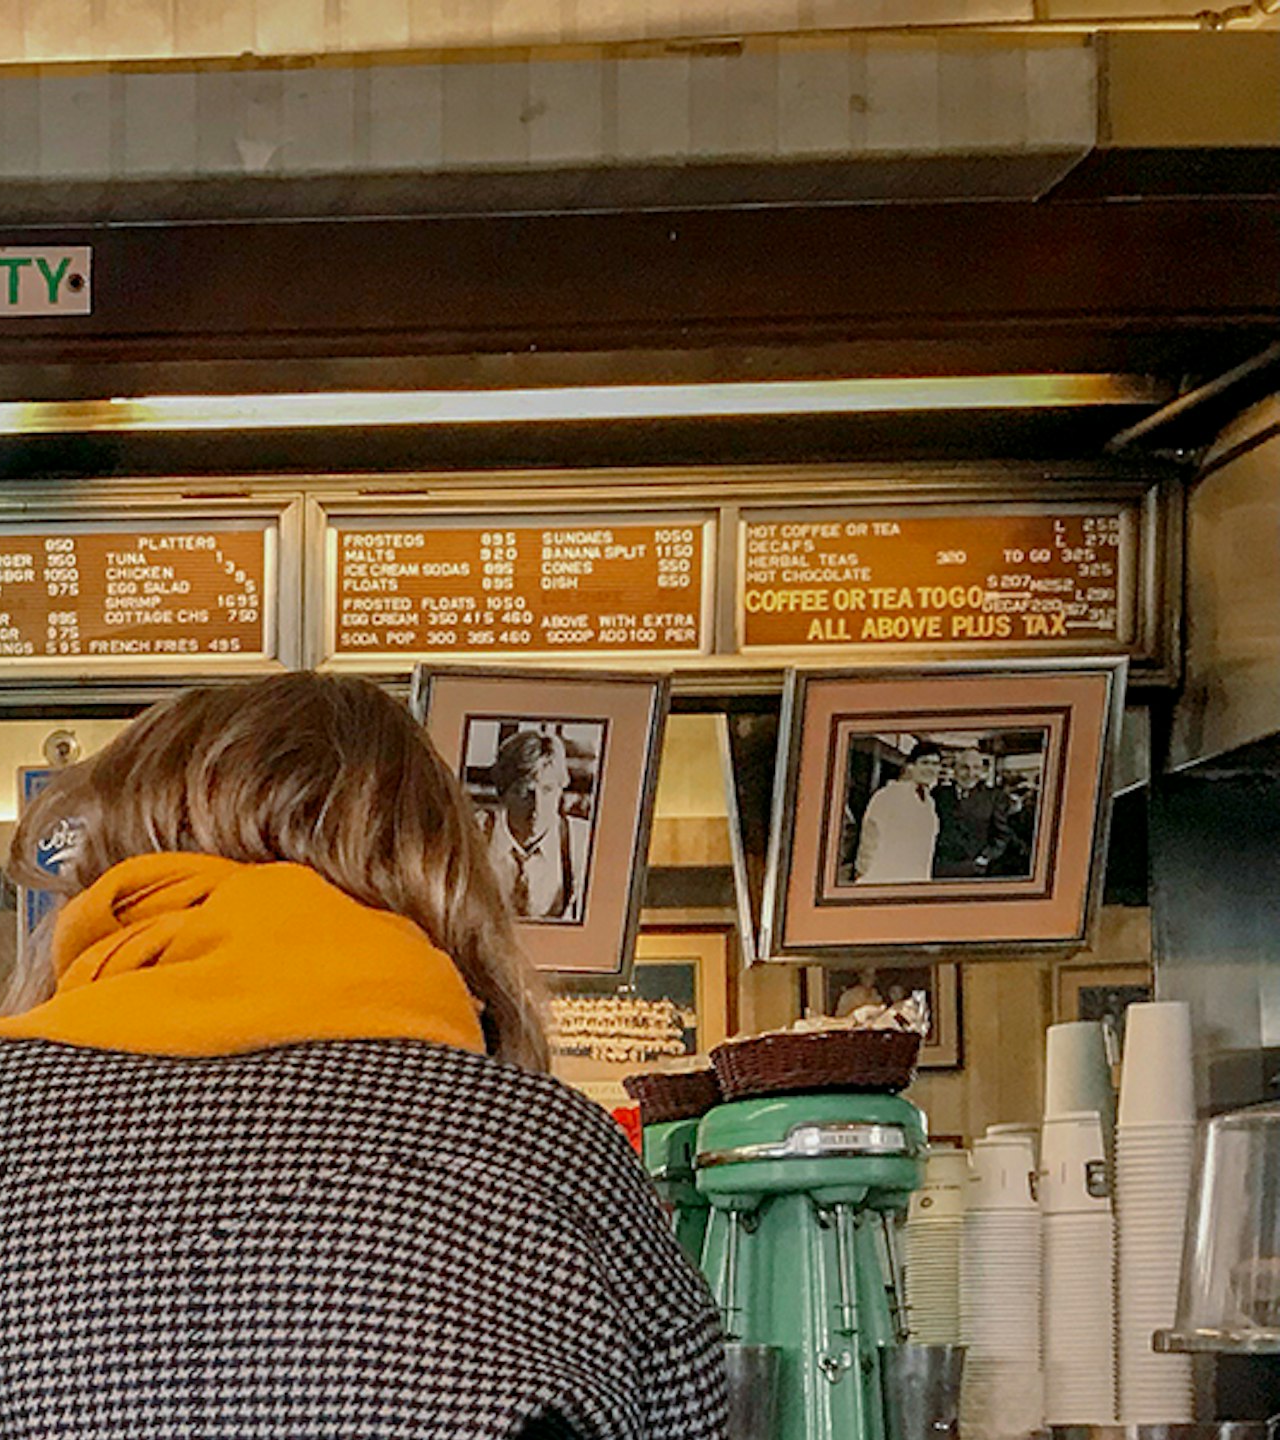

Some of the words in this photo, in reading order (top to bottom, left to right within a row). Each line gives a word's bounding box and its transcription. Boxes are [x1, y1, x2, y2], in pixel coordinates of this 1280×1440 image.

[748, 525, 776, 538] HOT
[781, 524, 840, 537] COFFEE
[847, 523, 869, 537] OR
[873, 523, 900, 535] TEA
[138, 537, 216, 549] PLATTERS
[344, 534, 424, 547] FROSTEDS
[542, 531, 613, 544] SUNDAES
[542, 546, 601, 559] BANANA
[605, 545, 646, 559] SPLIT
[748, 540, 815, 552] DECAFS
[106, 553, 146, 565] TUNA
[344, 550, 395, 562] MALTS
[748, 555, 809, 567] HERBAL
[819, 553, 858, 566] TEAS
[1004, 550, 1023, 563] TO
[1030, 550, 1050, 563] GO
[106, 567, 173, 579] CHICKEN
[344, 563, 369, 576] ICE
[371, 563, 418, 576] CREAM
[423, 562, 470, 576] SODAS
[542, 561, 592, 574] CONES
[747, 570, 775, 582] HOT
[782, 567, 871, 582] CHOCOLATE
[108, 582, 139, 594] EGG
[144, 581, 190, 594] SALAD
[344, 578, 398, 591] FLOATS
[542, 576, 578, 589] DISH
[106, 596, 161, 608] SHRIMP
[344, 598, 412, 611] FROSTED
[422, 597, 476, 610] FLOATS
[746, 591, 828, 613] COFFEE
[834, 590, 865, 611] OR
[868, 589, 918, 610] TEA
[105, 610, 172, 623] COTTAGE
[178, 610, 209, 622] CHS
[371, 612, 419, 625] CREAM
[541, 615, 588, 628] ABOVE
[599, 615, 636, 628] WITH
[643, 614, 694, 627] EXTRA
[807, 619, 851, 640] ALL
[862, 617, 941, 640] ABOVE
[952, 616, 1010, 637] PLUS
[1022, 615, 1067, 636] TAX
[341, 632, 379, 646] SODA
[386, 631, 415, 645] POP
[547, 629, 594, 642] SCOOP
[599, 629, 628, 642] ADD
[665, 628, 695, 641] PER
[91, 640, 149, 652] FRENCH
[154, 639, 199, 652] FRIES
